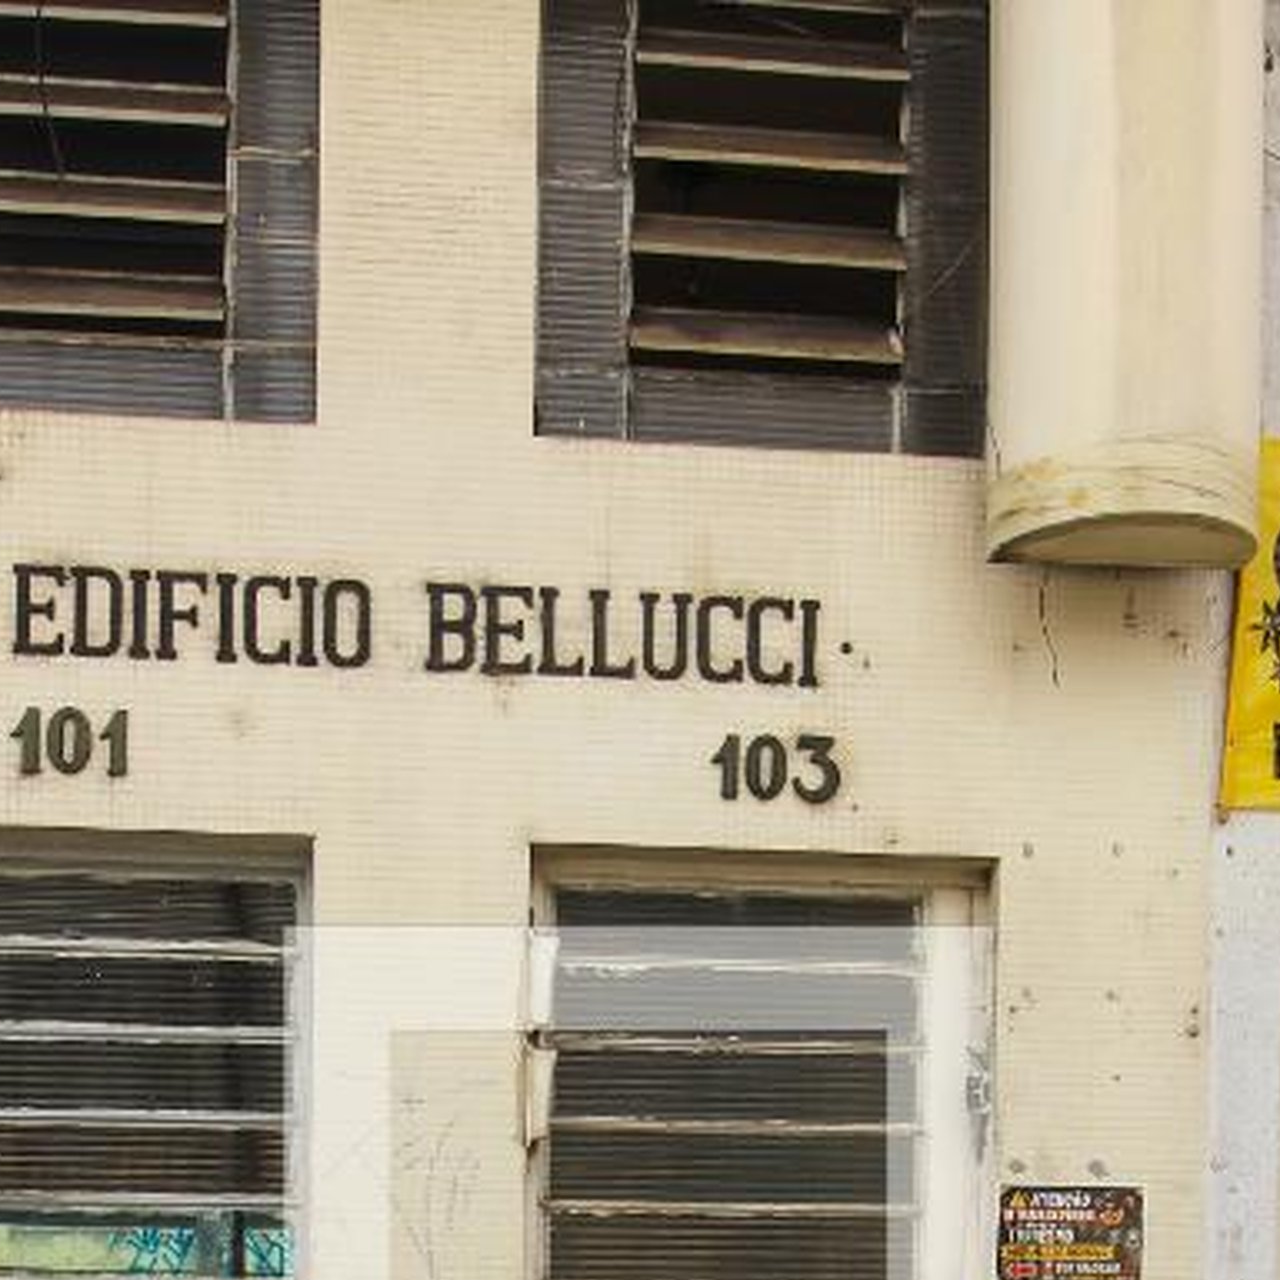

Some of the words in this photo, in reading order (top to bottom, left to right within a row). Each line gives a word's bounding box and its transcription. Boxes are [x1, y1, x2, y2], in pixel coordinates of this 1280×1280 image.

[11, 564, 373, 668] EDIFICIO
[424, 581, 822, 688] BELLUCCI
[10, 706, 130, 777] 101
[711, 734, 842, 803] 103
